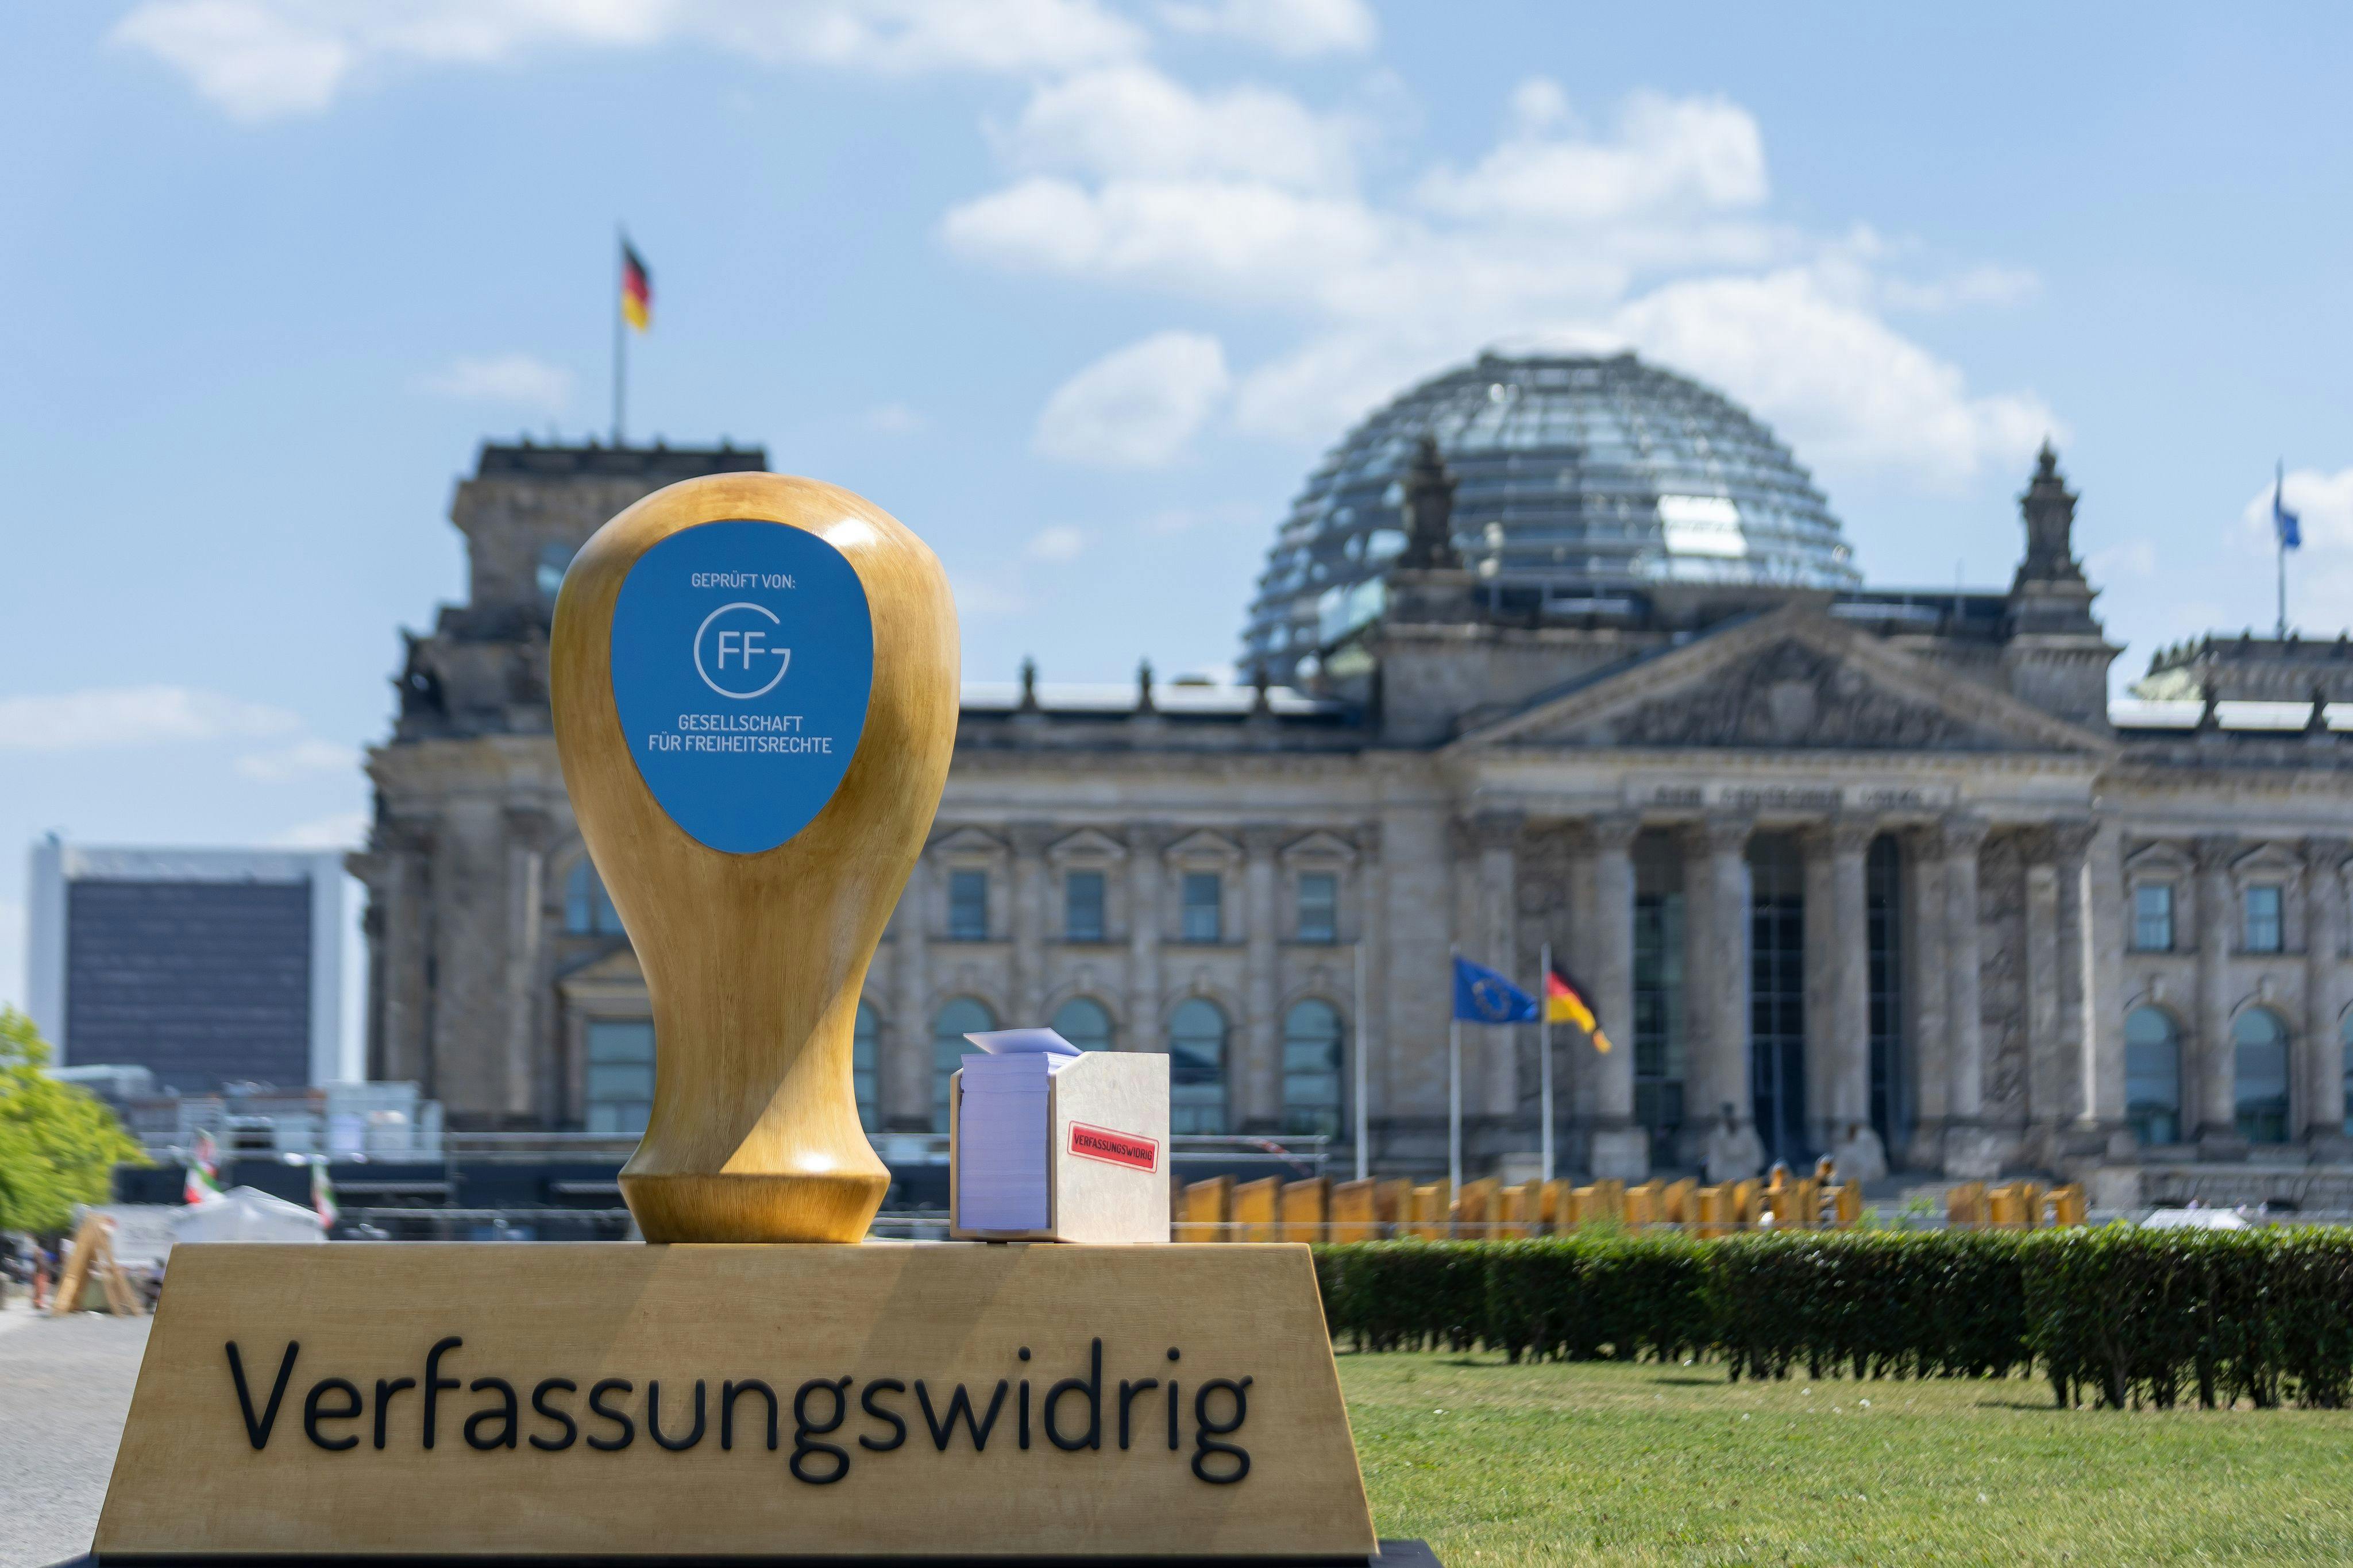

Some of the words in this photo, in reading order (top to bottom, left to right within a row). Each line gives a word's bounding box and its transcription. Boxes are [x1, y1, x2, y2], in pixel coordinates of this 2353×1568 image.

[691, 570, 758, 589] GEPRÜFT
[762, 574, 796, 589] VON:
[678, 714, 803, 732] GESELLSCHAFT
[649, 731, 681, 751] FÜR
[685, 735, 832, 754] FREIHEITSRECHTE
[1074, 1133, 1152, 1161] VERFASSUNGSWIDRIG
[225, 1335, 1253, 1486] Verfassungswidrig
